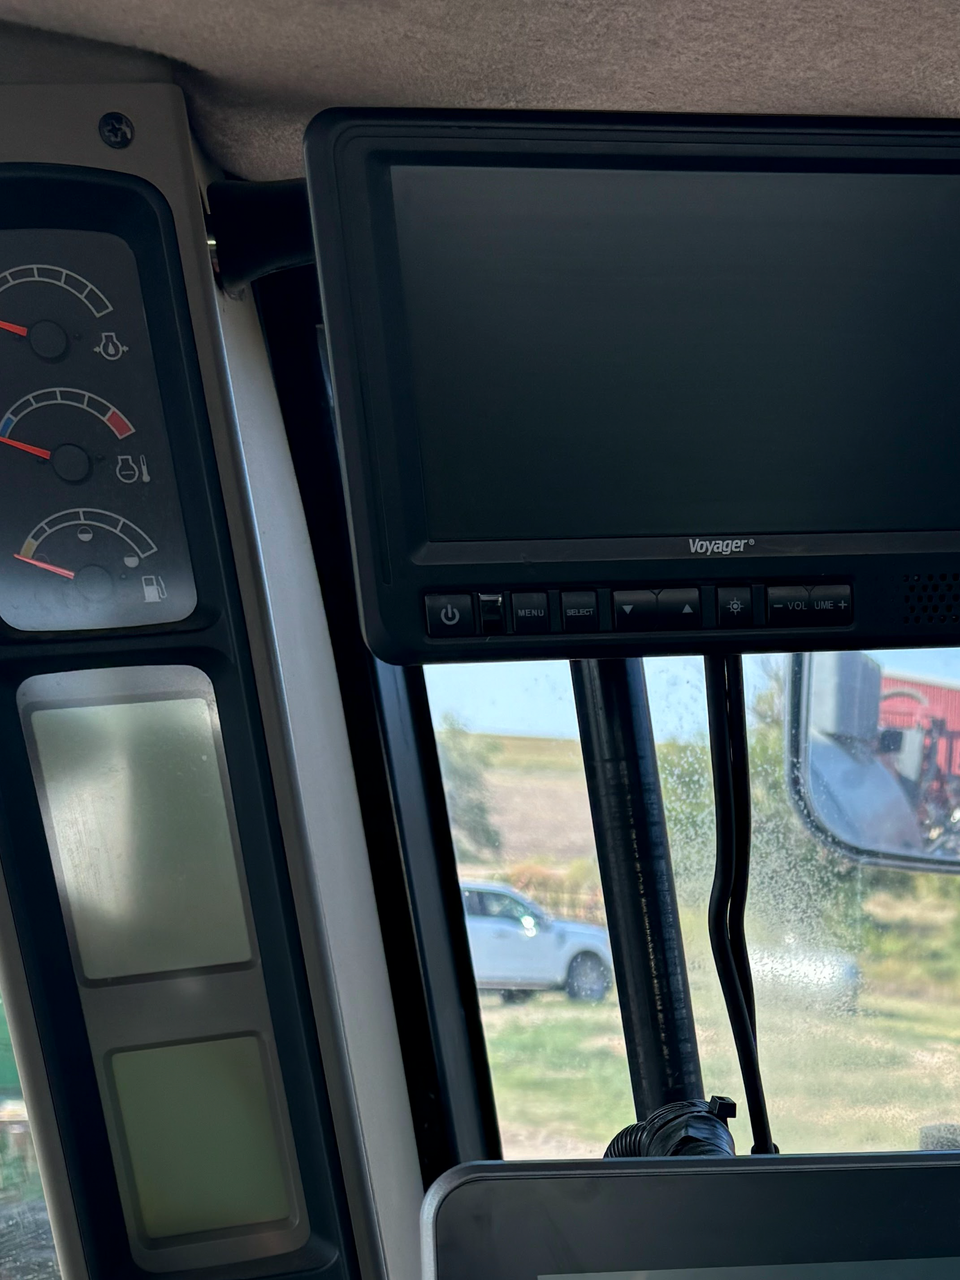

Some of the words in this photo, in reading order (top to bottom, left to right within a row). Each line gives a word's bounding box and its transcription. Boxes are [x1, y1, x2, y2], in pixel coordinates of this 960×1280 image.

[787, 600, 808, 611] VOL
[814, 599, 834, 610] UME
[517, 608, 545, 618] MENU
[566, 608, 594, 617] SELECT
